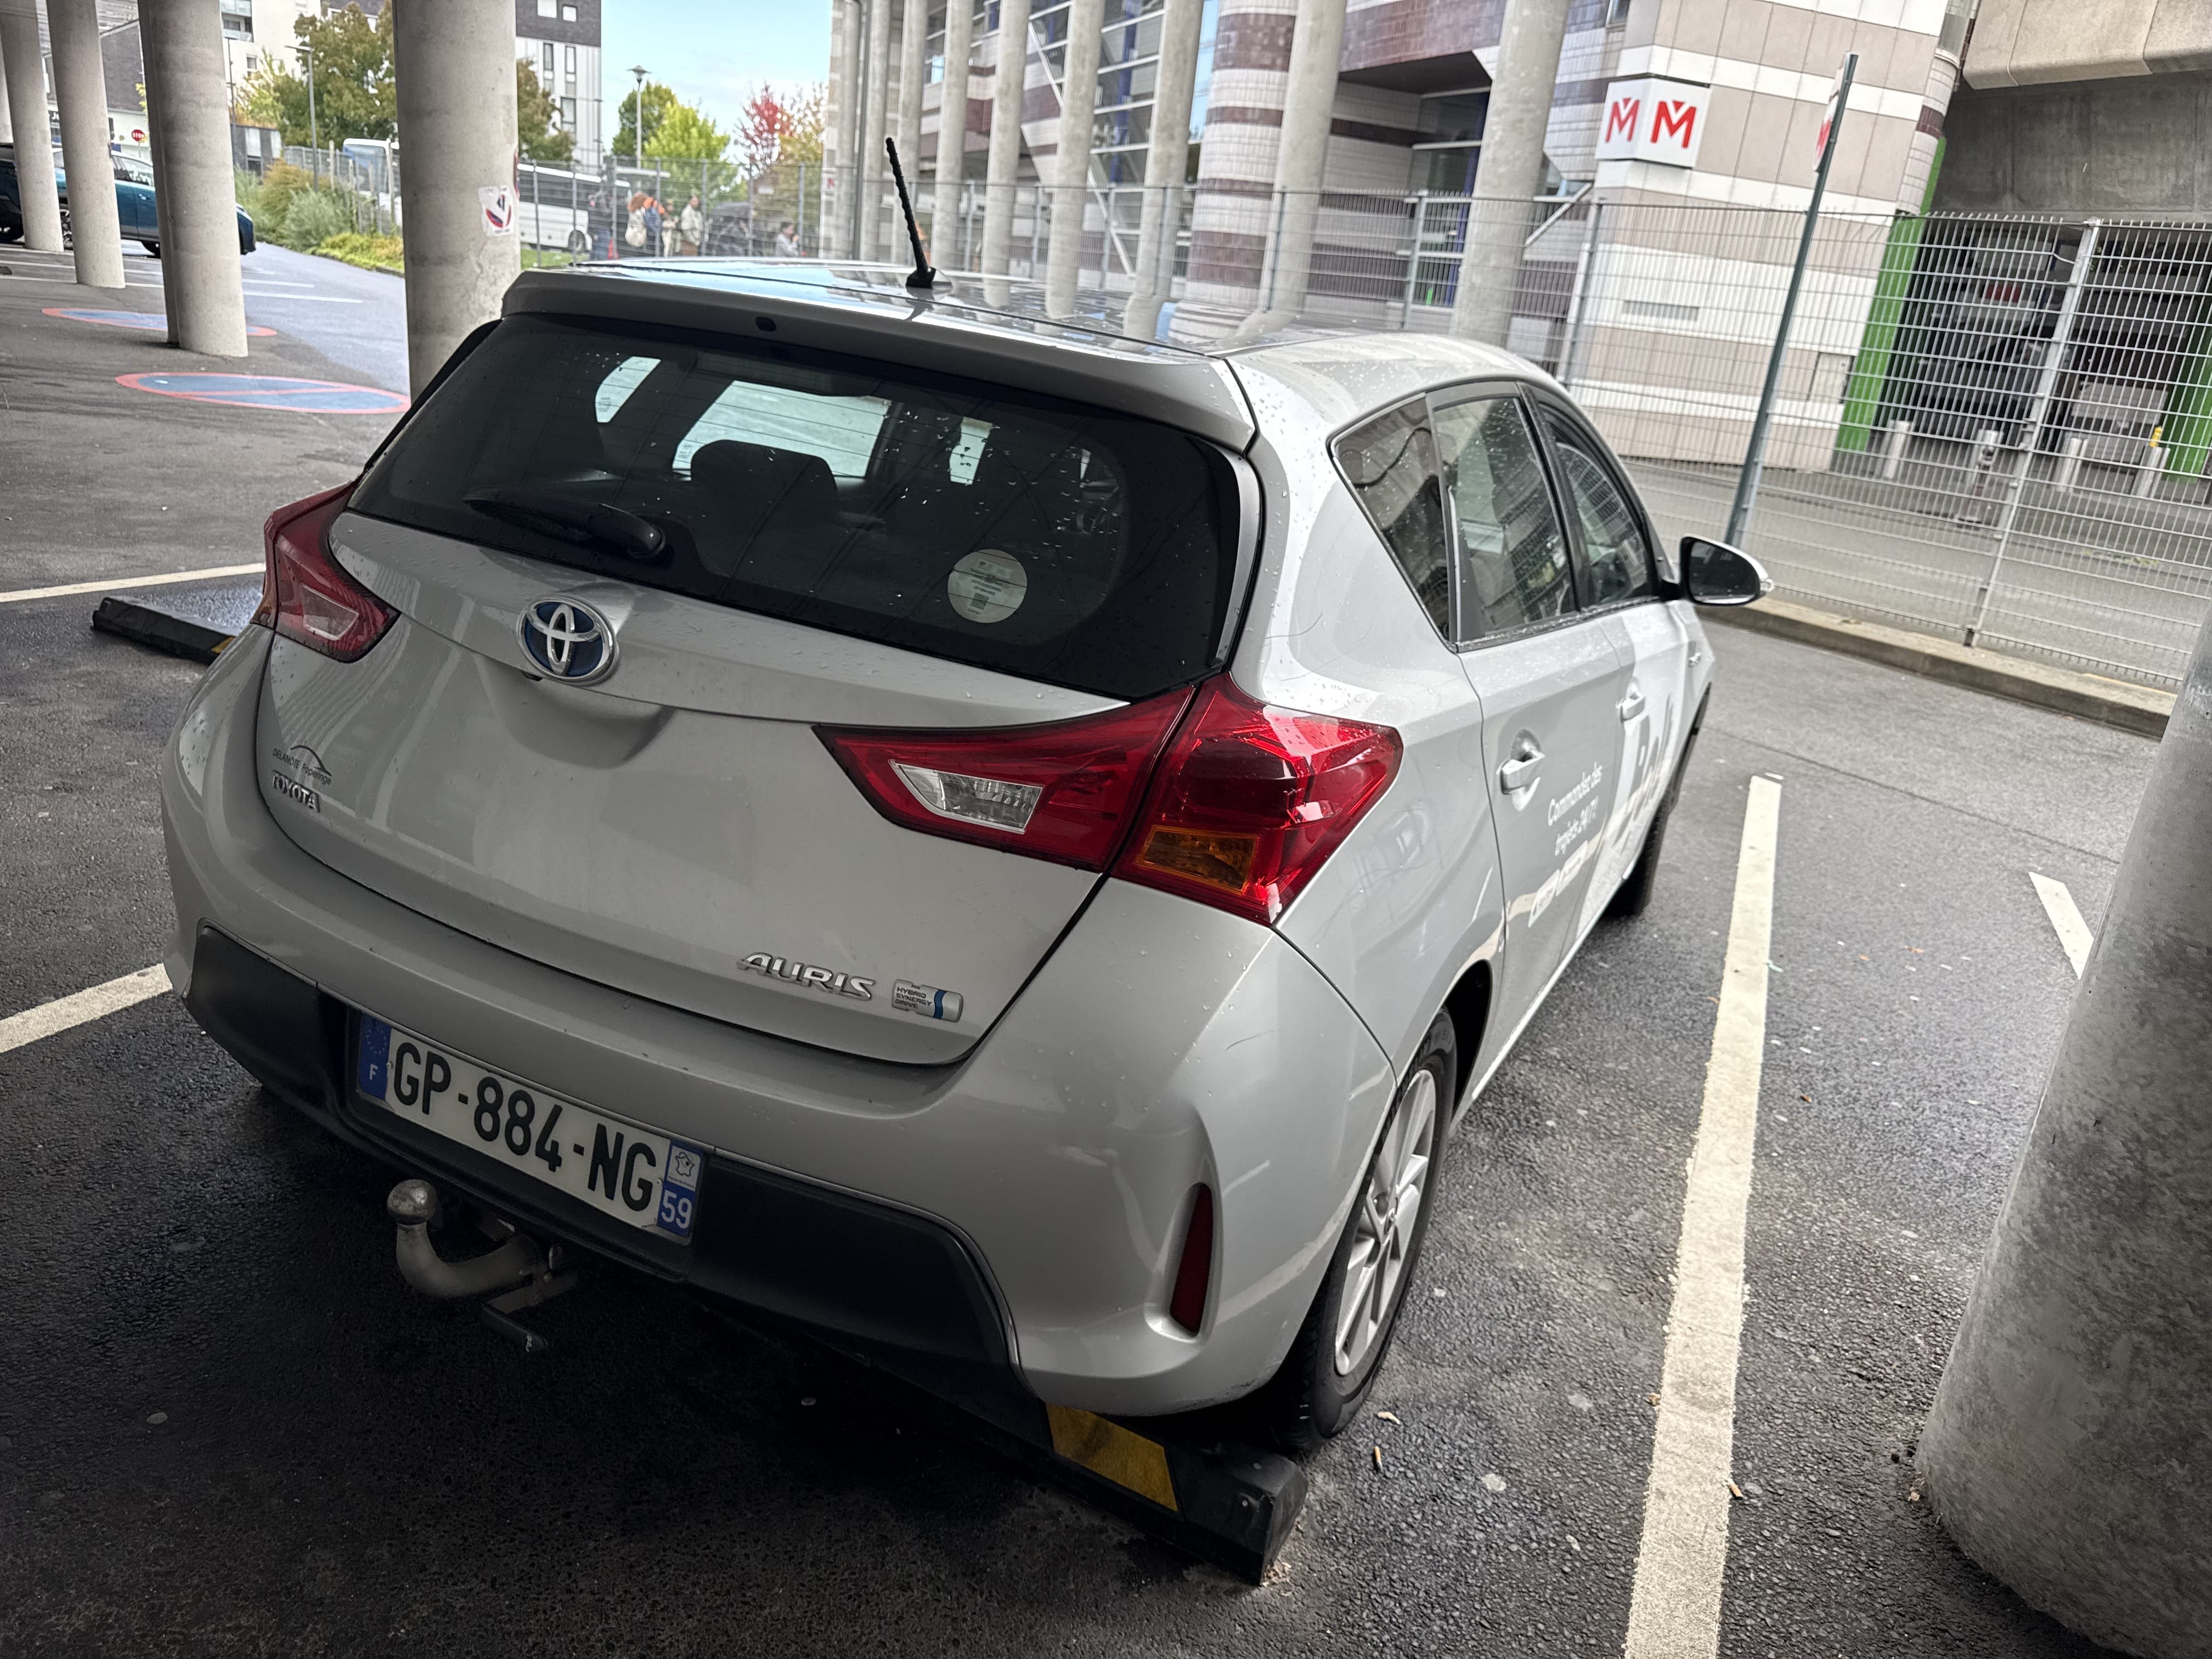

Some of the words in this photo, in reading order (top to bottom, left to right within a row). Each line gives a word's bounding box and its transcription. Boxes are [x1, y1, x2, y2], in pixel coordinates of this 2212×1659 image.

[1605, 97, 1640, 143] M
[1650, 100, 1697, 149] M
[272, 770, 320, 813] TOYOTA
[737, 952, 877, 1001] AURIS
[898, 988, 926, 998] HYBRID
[895, 999, 918, 1008] DRIVE
[896, 993, 932, 1006] SYNERGY
[369, 1064, 379, 1081] F
[393, 1042, 657, 1212] GP-884-NG
[661, 1192, 693, 1229] 59
